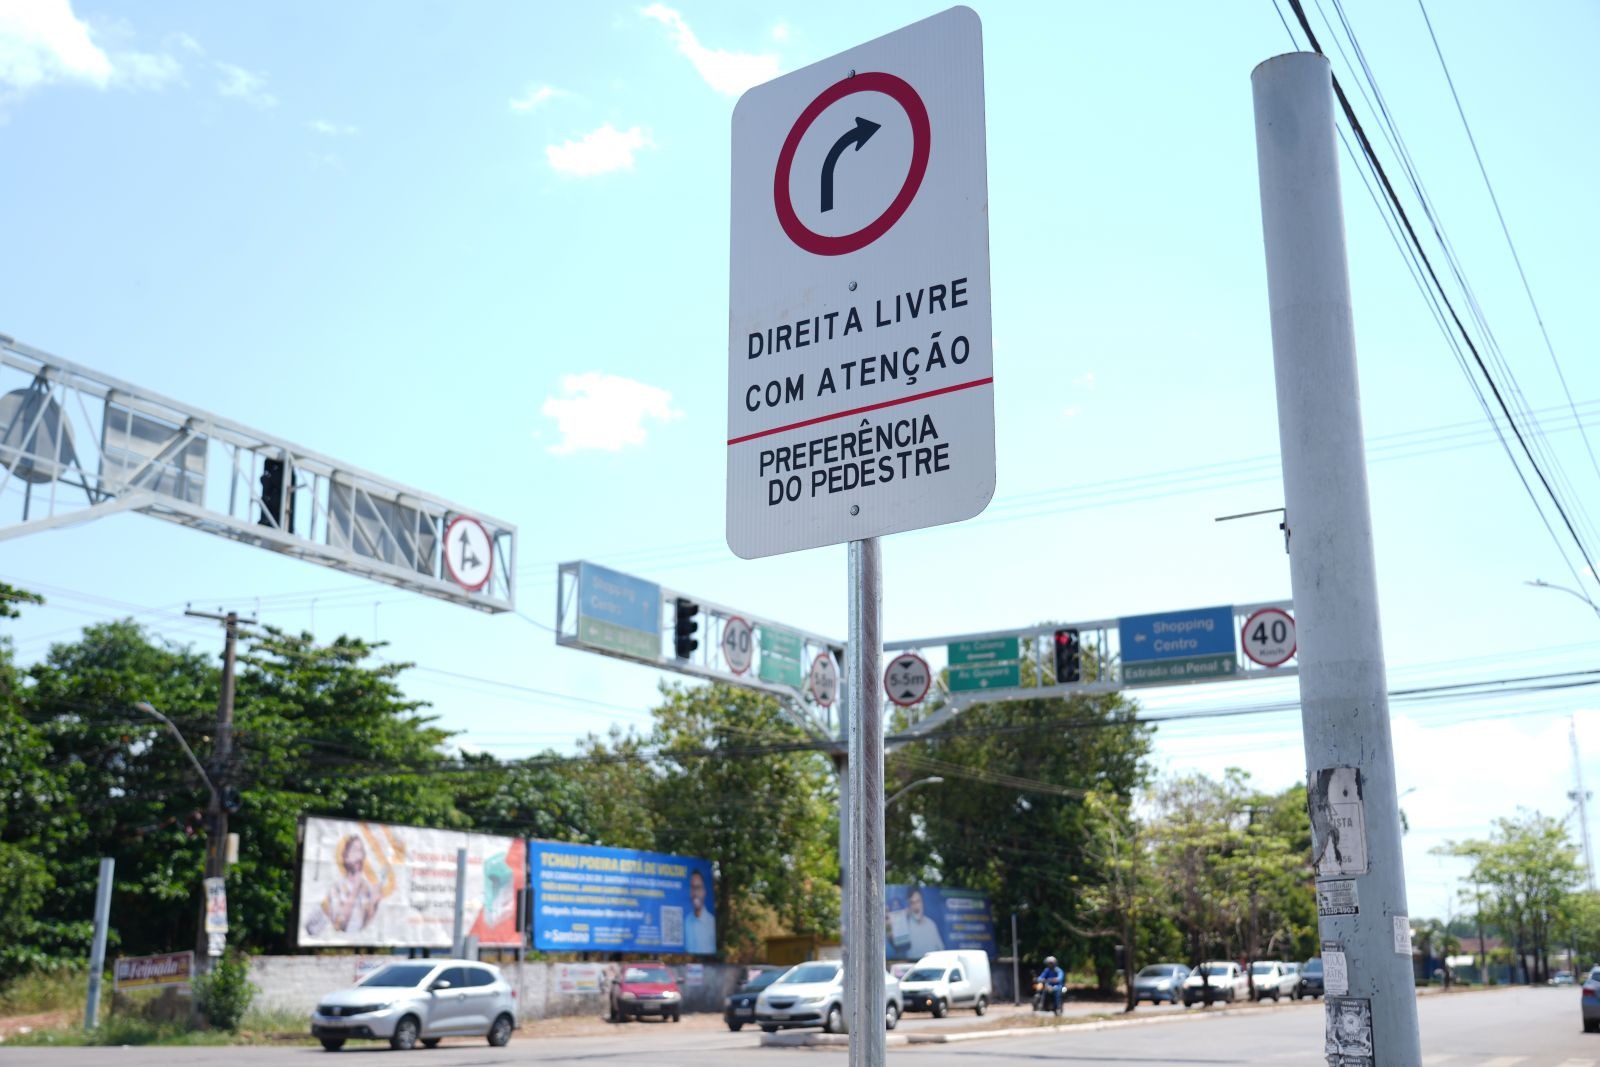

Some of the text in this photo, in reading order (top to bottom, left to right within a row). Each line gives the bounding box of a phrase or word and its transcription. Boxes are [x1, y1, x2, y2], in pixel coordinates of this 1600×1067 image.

[748, 277, 969, 359] DIREITA LIVRE
[745, 330, 970, 412] COM ATENÇÃO
[759, 413, 939, 478] PREFERÊNCIA
[768, 442, 950, 506] DO PEDESTRE
[1153, 618, 1214, 634] Shopping
[1252, 620, 1287, 645] 40
[726, 627, 749, 652] 40
[1154, 638, 1197, 651] Centro
[1125, 659, 1218, 679] Estrada da Penal
